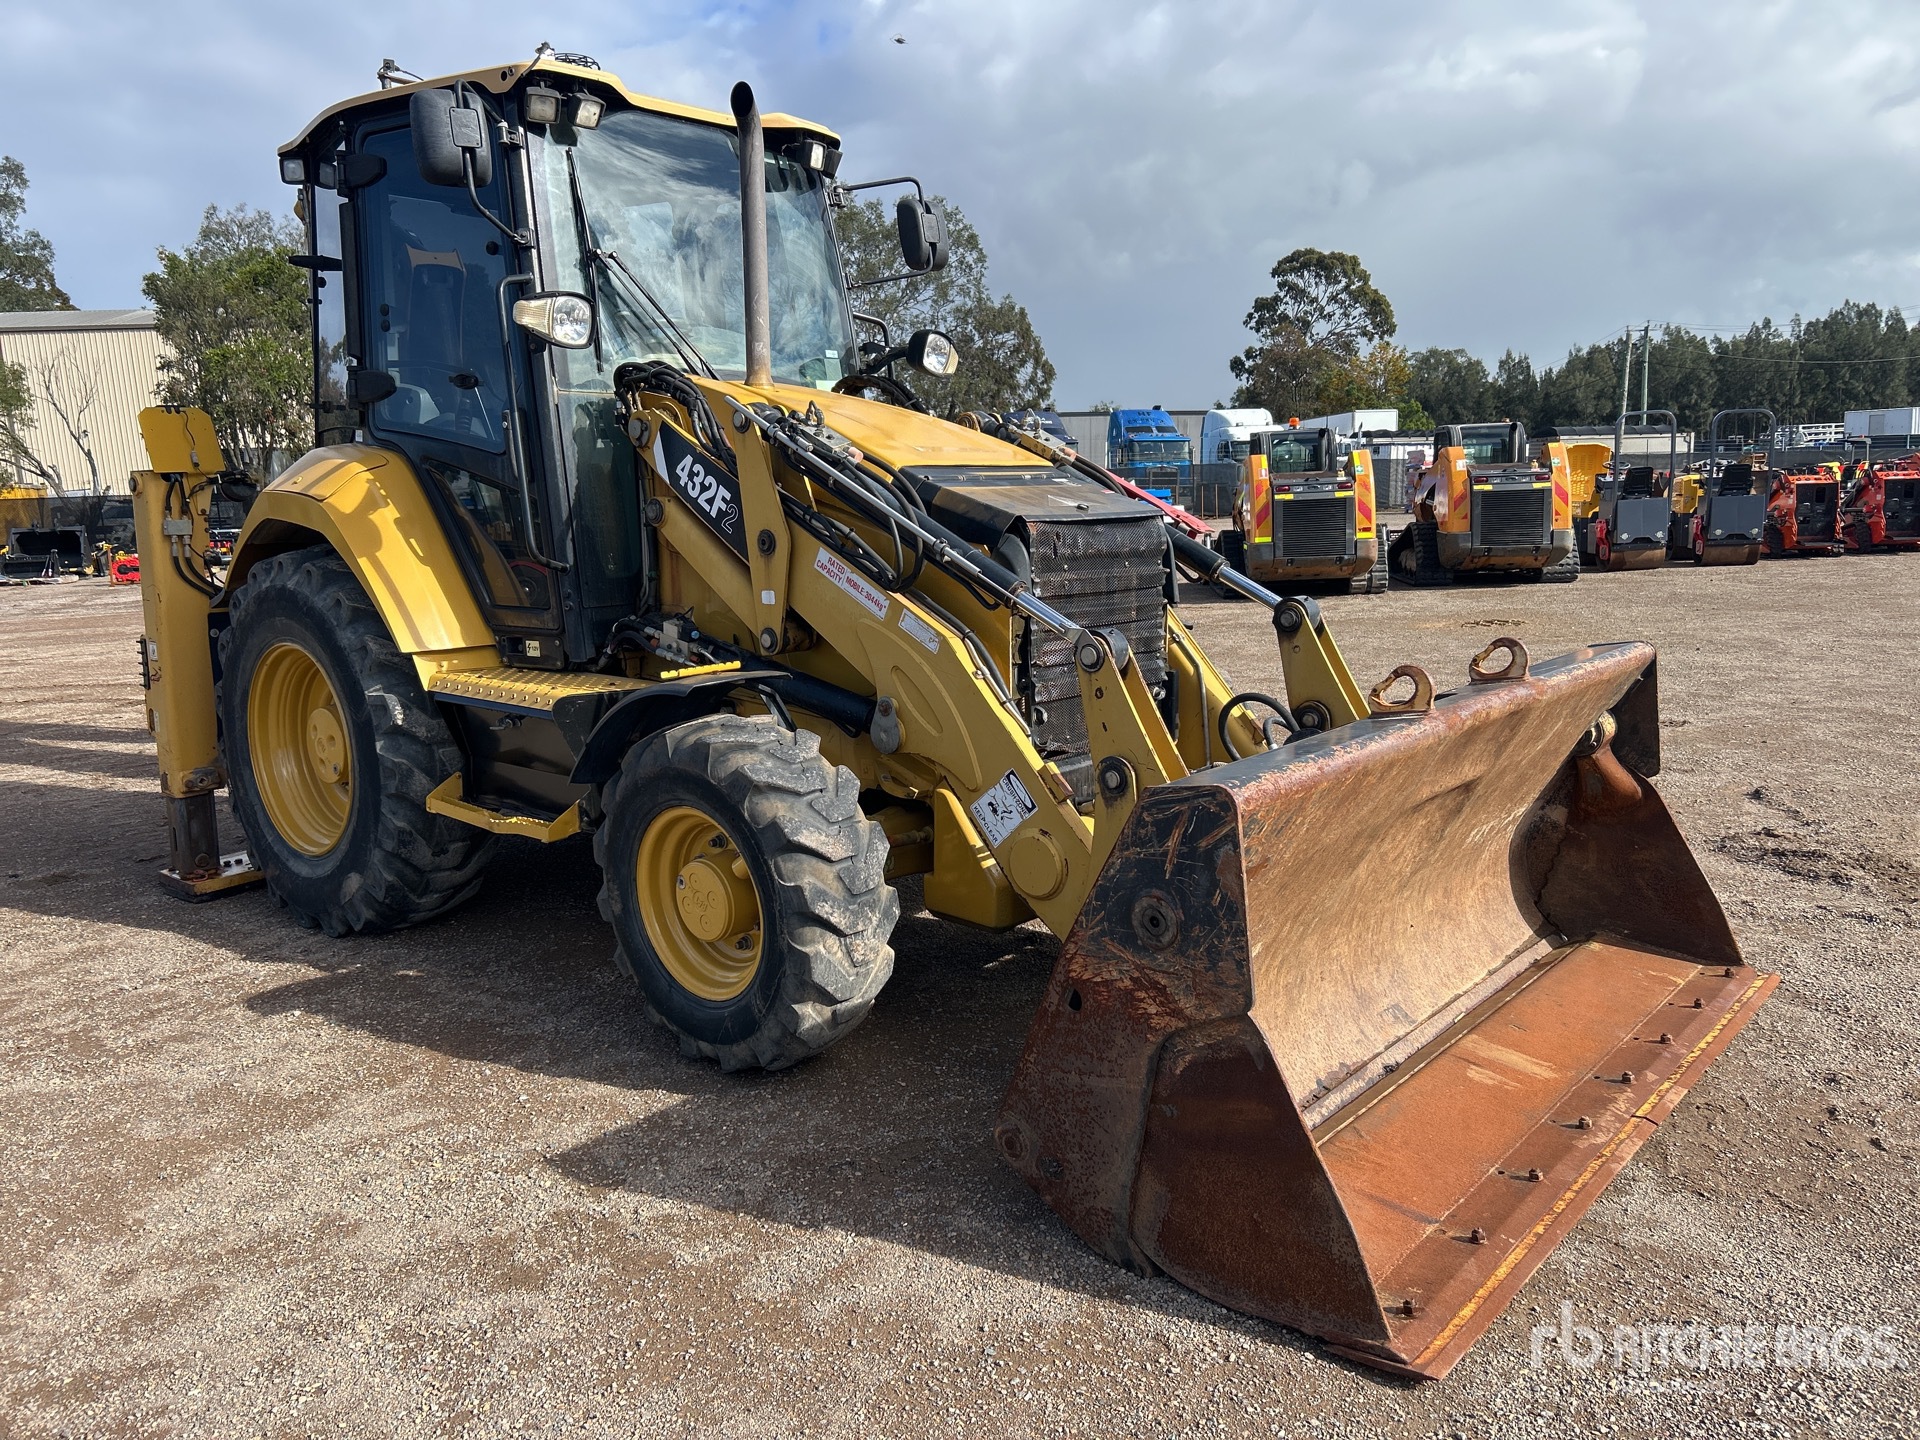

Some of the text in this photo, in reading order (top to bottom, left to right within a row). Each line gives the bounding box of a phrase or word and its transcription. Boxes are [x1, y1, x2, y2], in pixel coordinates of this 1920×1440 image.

[816, 559, 843, 583] CAPACITY
[827, 556, 845, 575] RATED
[1002, 778, 1029, 817] CRUSH ZONE
[973, 805, 998, 843] KEEP CLEAR
